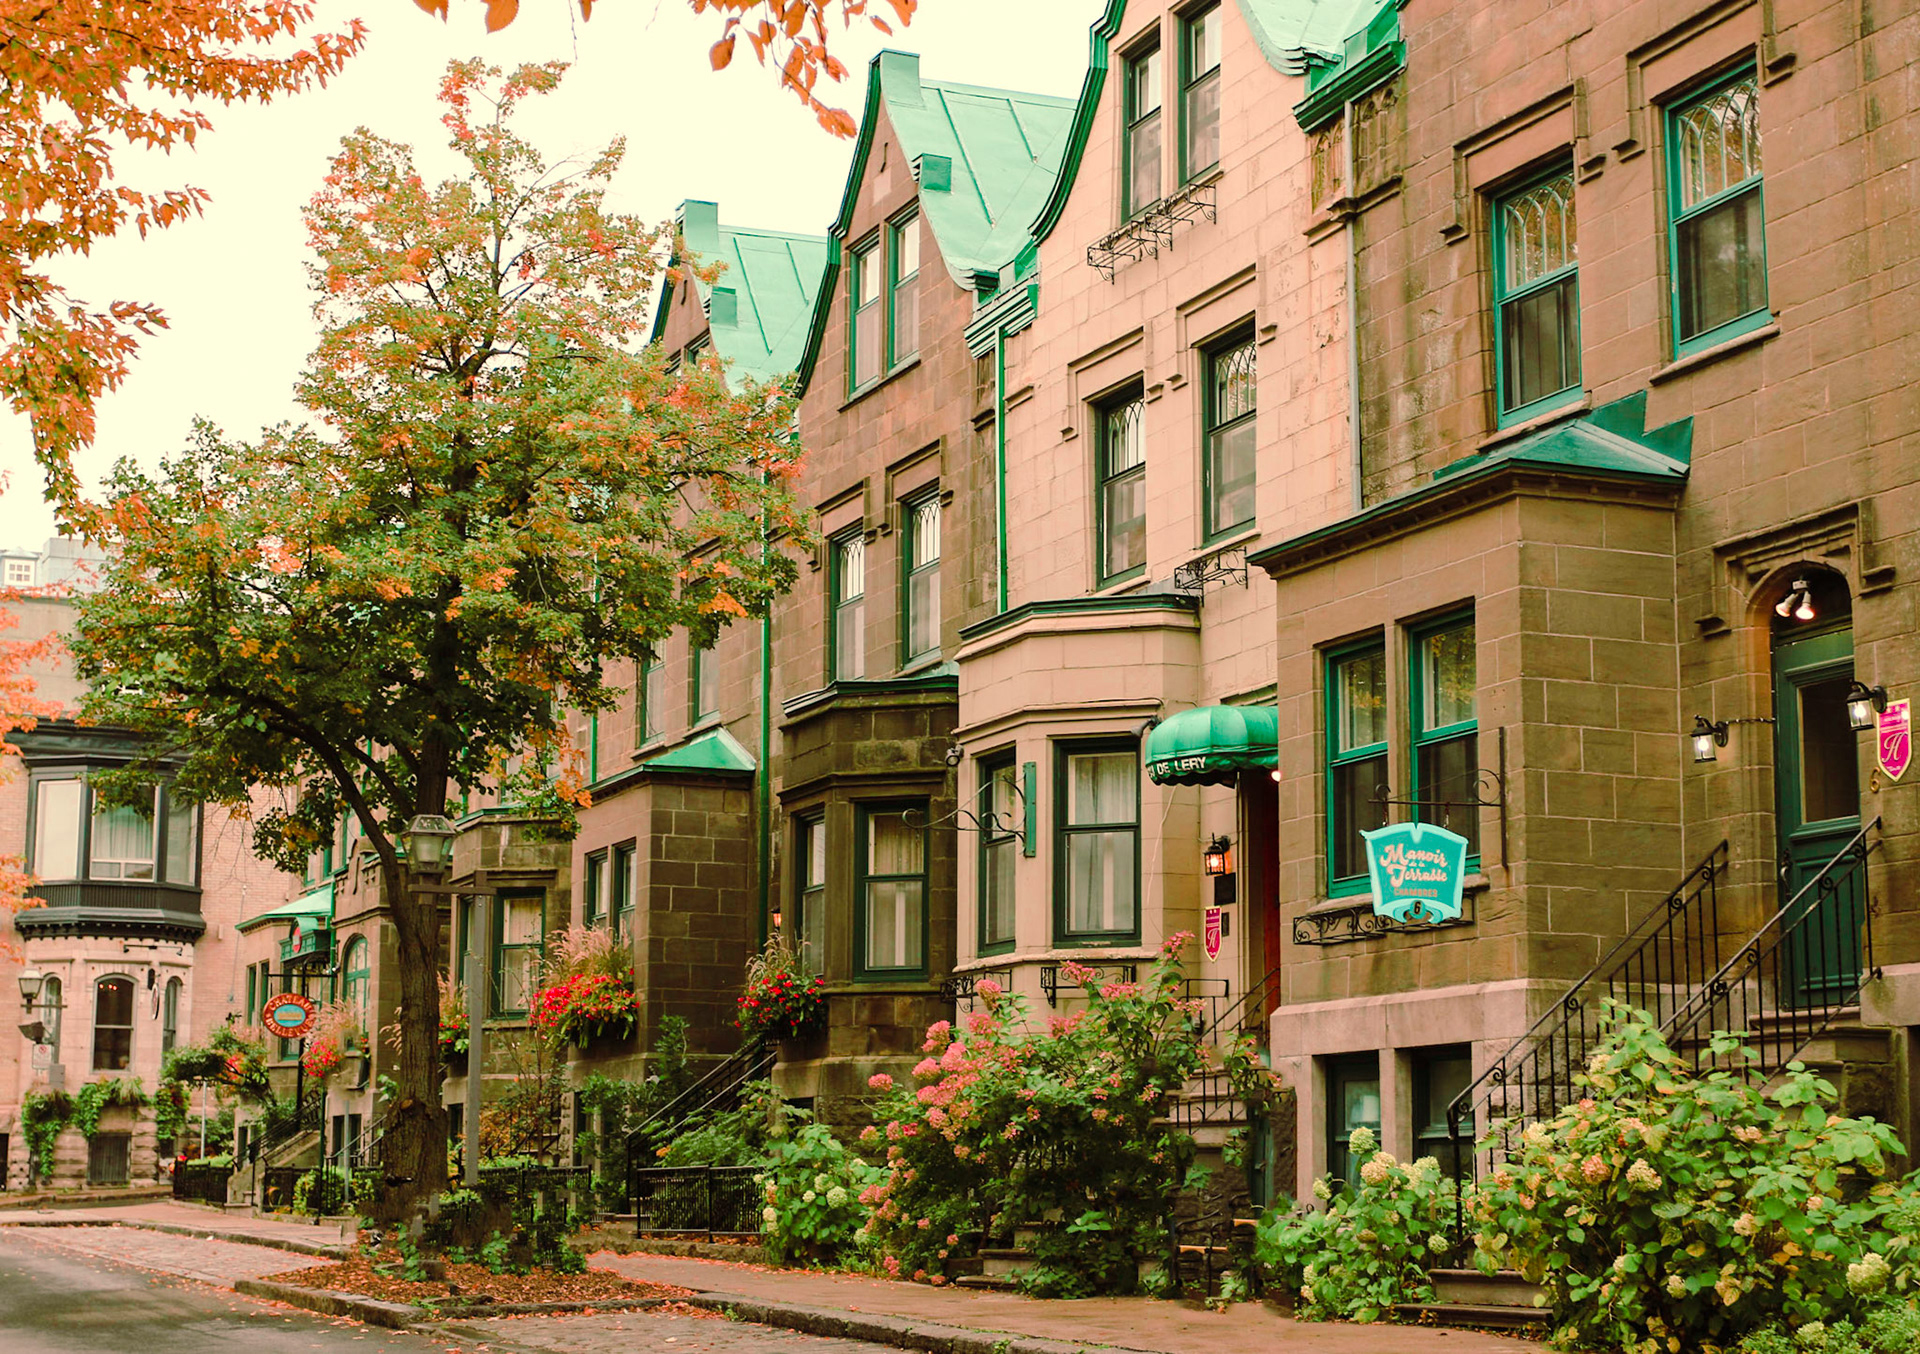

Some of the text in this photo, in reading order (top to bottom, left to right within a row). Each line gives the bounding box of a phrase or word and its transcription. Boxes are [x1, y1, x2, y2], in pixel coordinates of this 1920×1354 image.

[1156, 762, 1171, 775] DE
[1174, 756, 1206, 771] LERY
[1870, 766, 1881, 793] 6
[1379, 843, 1448, 868] Manoir
[1386, 864, 1448, 888] Terrasse
[1394, 888, 1438, 897] CHAMBRES
[1414, 901, 1421, 914] 6
